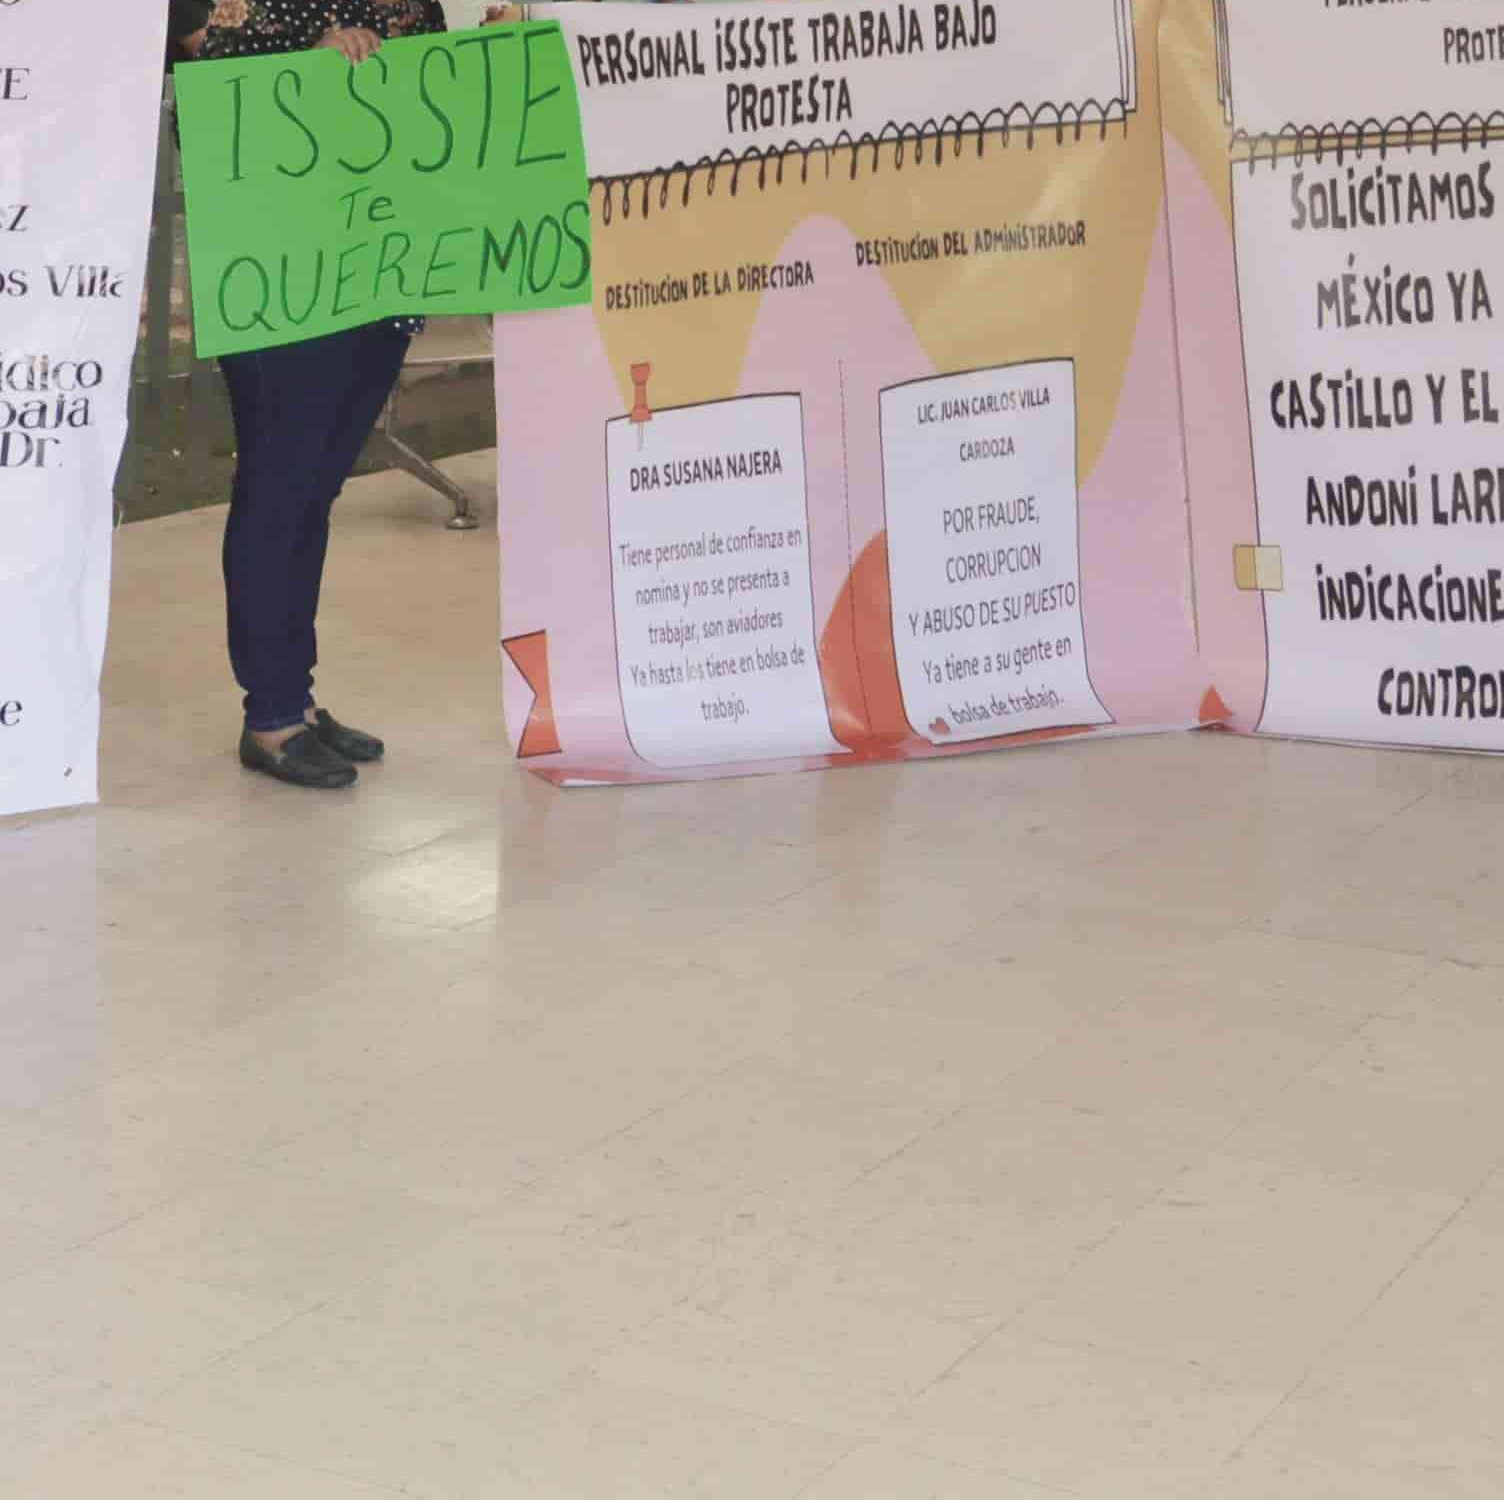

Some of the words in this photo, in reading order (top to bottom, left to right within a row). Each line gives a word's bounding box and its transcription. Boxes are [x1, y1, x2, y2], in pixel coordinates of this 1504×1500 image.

[577, 28, 705, 87] PERSONAL
[808, 4, 924, 64] TRABAJA
[224, 26, 566, 182] ISSSTE
[725, 74, 853, 134] PROTESTA
[337, 185, 396, 229] Te
[218, 200, 590, 331] QUEREMOS
[1447, 268, 1493, 322] YA
[1426, 373, 1446, 425] Y
[1460, 368, 1500, 425] EL
[664, 455, 723, 487] SUSANA
[726, 448, 782, 478] NAJERA
[923, 603, 975, 636] ABUSO
[1024, 581, 1076, 616] PUESTO
